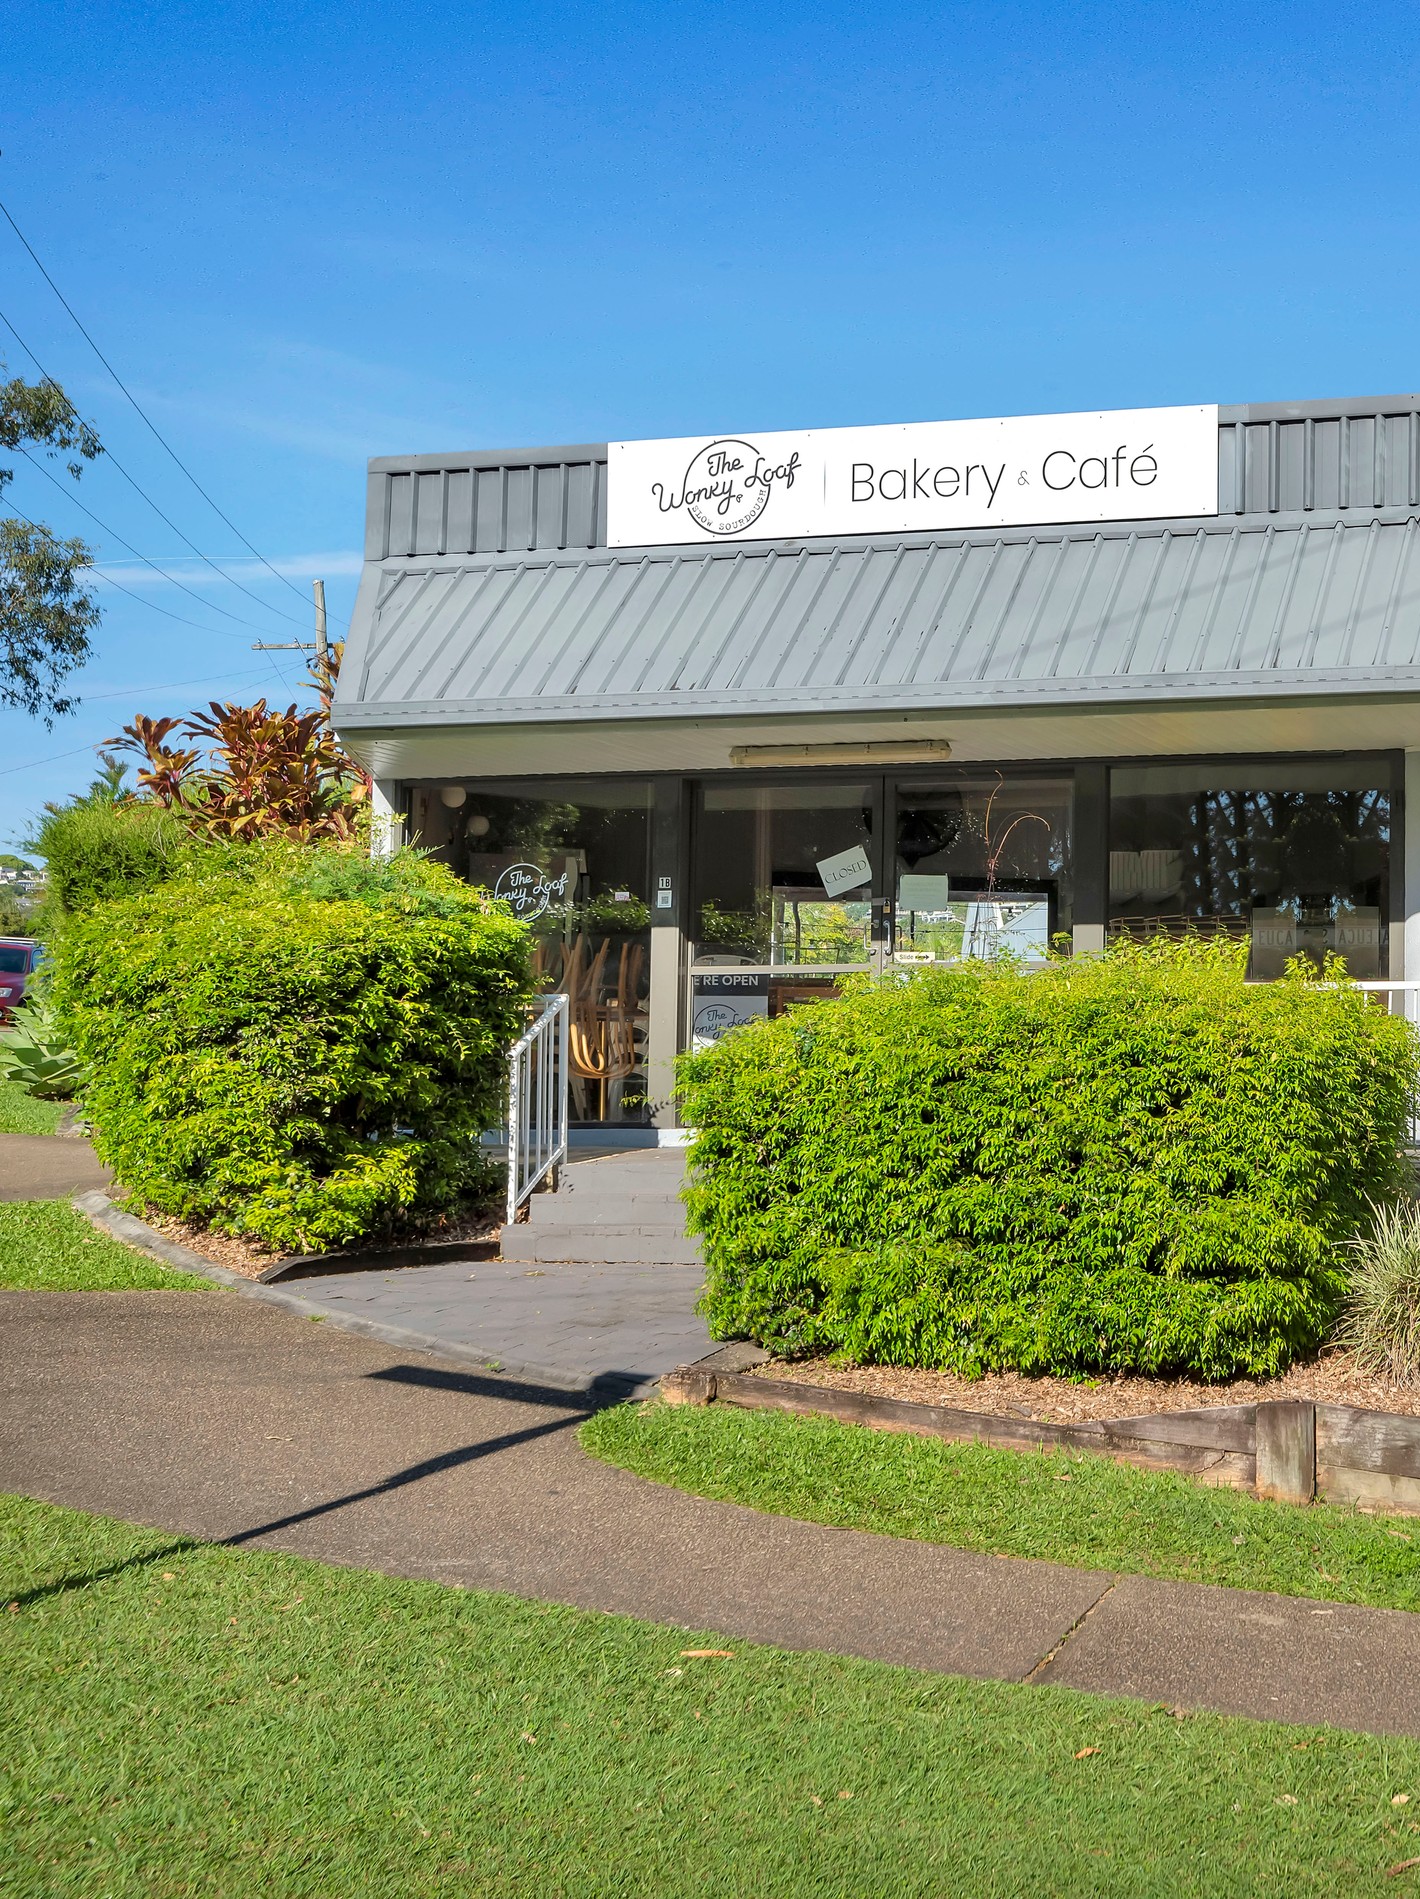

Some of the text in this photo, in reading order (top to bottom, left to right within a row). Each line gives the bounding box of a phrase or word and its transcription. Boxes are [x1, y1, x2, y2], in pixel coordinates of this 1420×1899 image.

[707, 451, 744, 477] The
[851, 443, 1158, 509] Bakery & Café
[651, 452, 802, 515] Wonky Loaf
[691, 489, 767, 531] SLOW SOURDOUGH
[509, 870, 534, 887] The
[660, 878, 671, 888] 1B
[824, 859, 867, 884] CLOSED
[494, 888, 529, 911] onky
[532, 872, 569, 896] Loaf
[722, 975, 759, 986] OPEN
[706, 1009, 728, 1022] The
